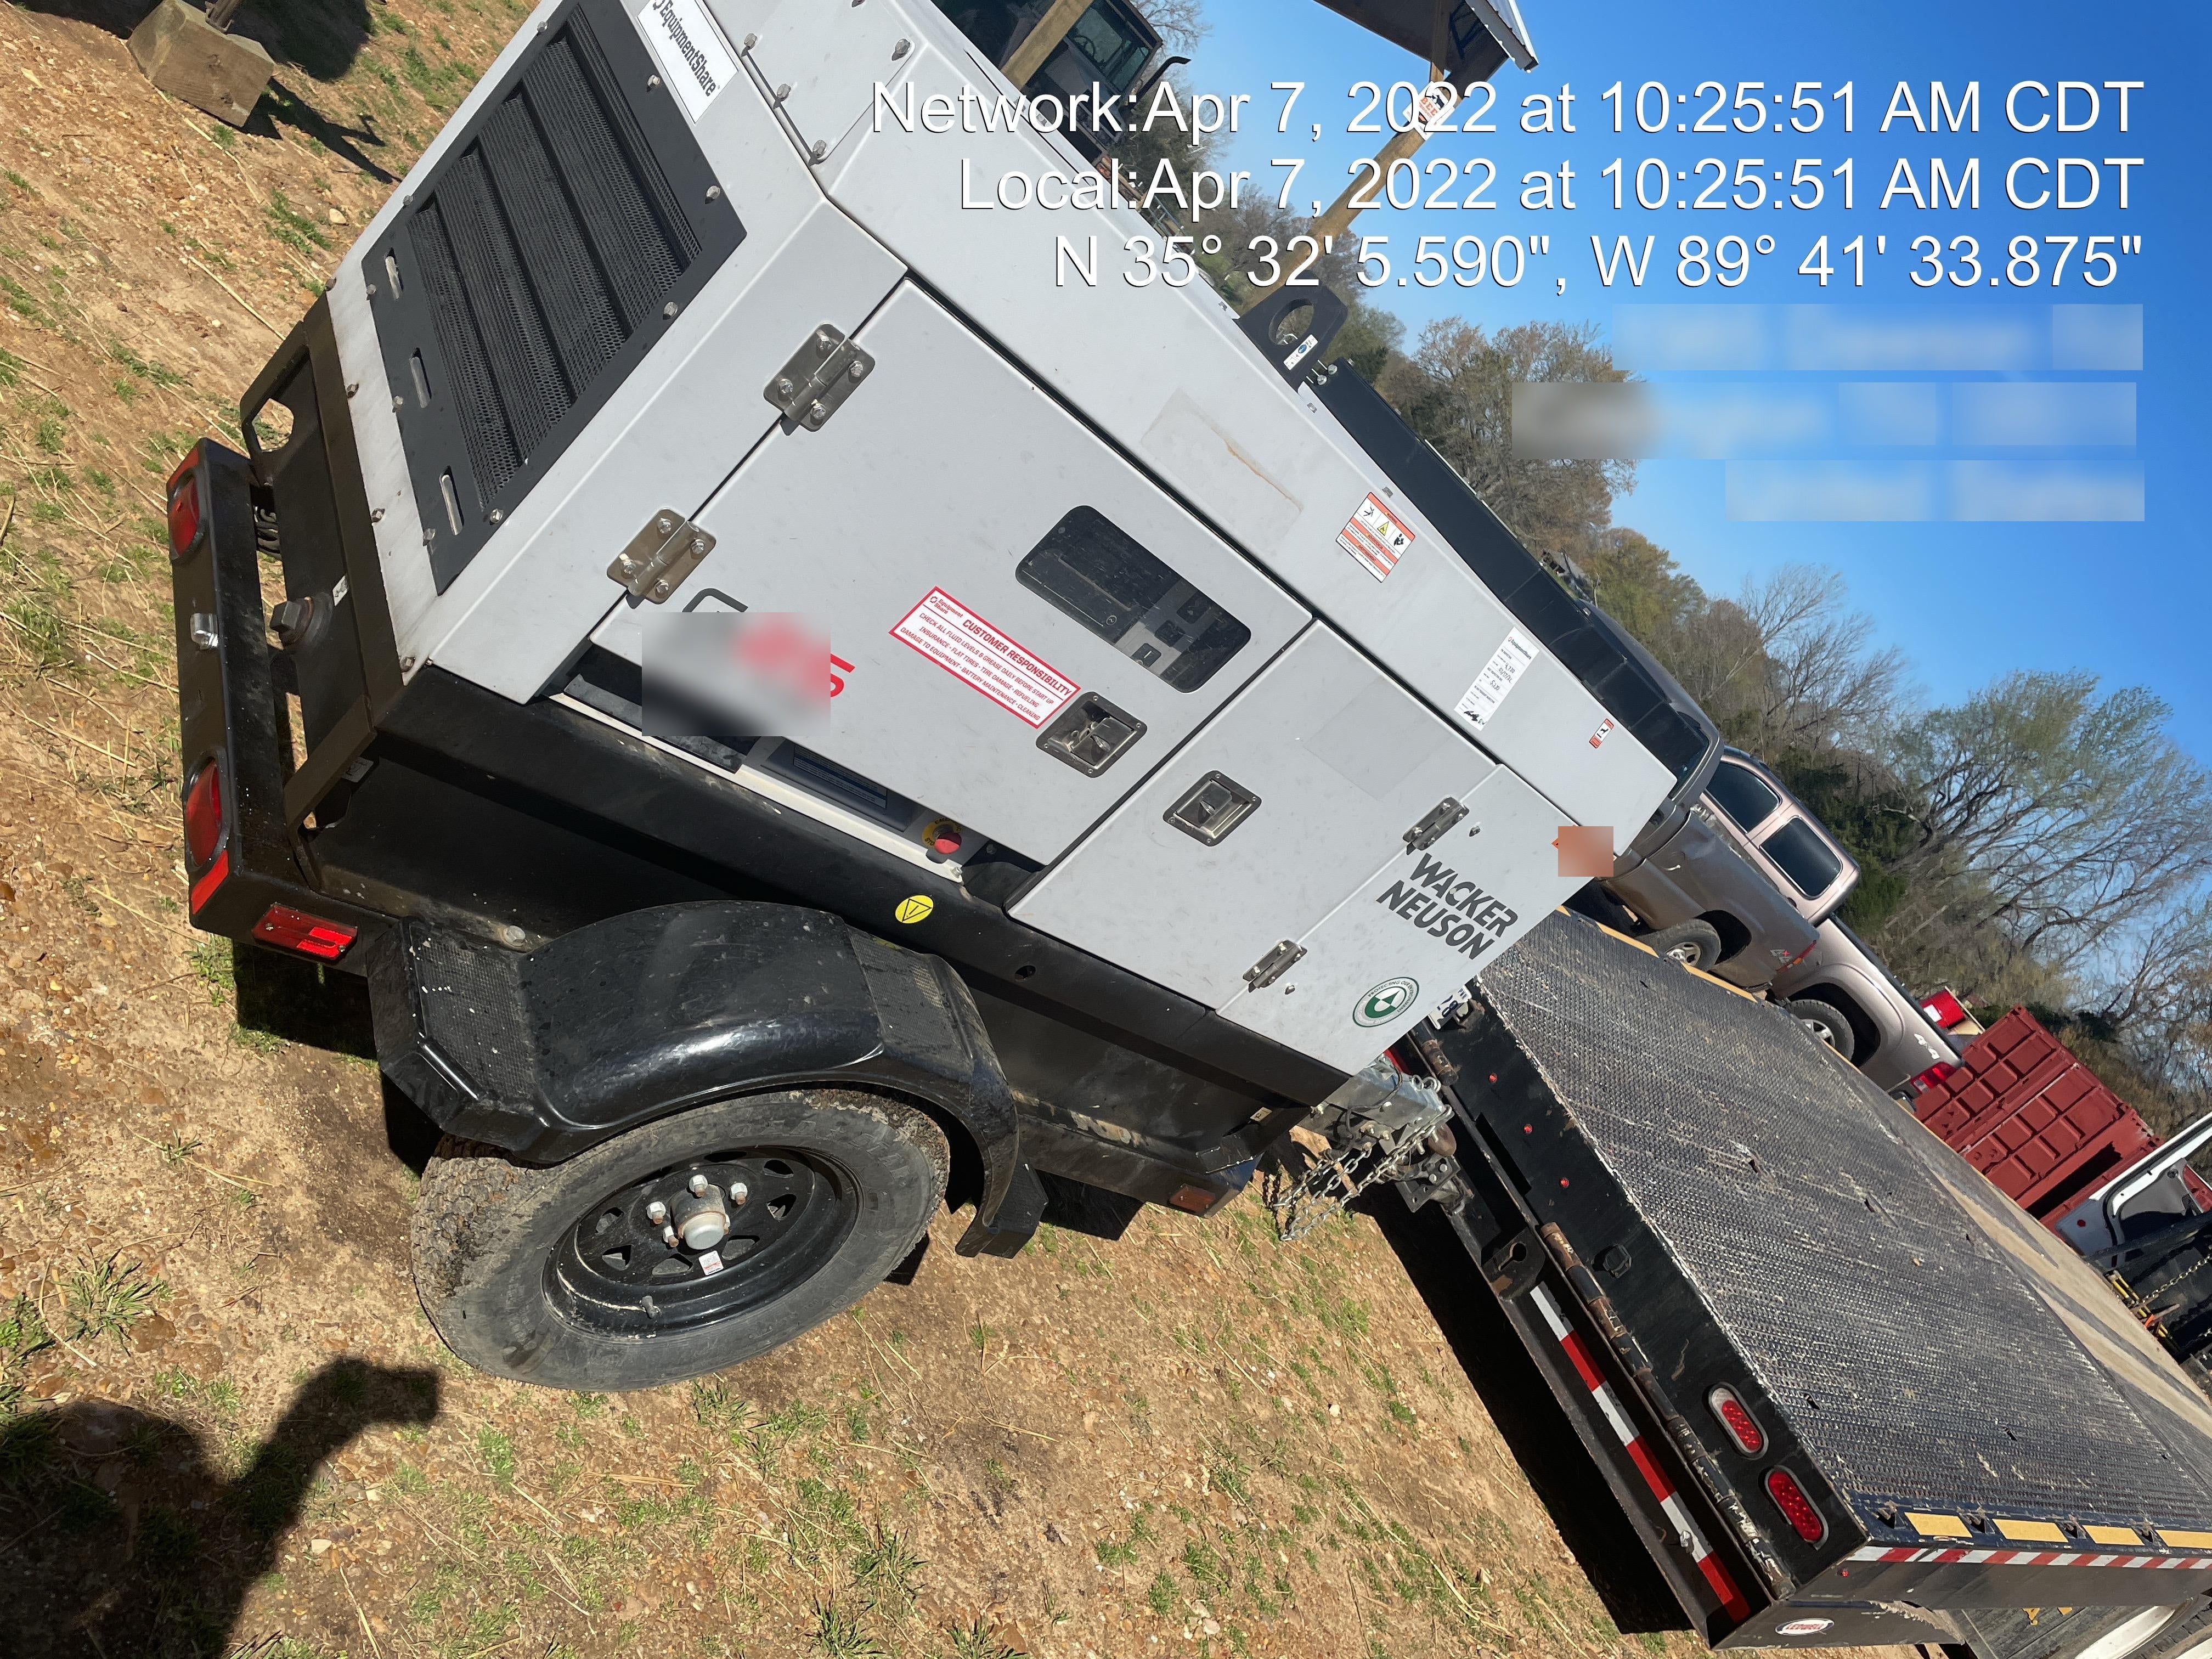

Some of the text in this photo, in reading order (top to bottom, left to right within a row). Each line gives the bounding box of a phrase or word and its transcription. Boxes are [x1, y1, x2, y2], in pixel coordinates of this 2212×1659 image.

[659, 0, 716, 97] EquipmentShare
[938, 599, 963, 618] Equipment
[900, 627, 924, 644] DAMAGE
[929, 646, 961, 668] EQUIPMENT
[961, 667, 984, 683] BATTERY
[981, 680, 1017, 705] MAINTENANCE
[1017, 704, 1041, 720] CLEANING
[919, 612, 938, 627] CHECK
[936, 624, 947, 634] ALL
[945, 630, 962, 644] FLUID
[960, 640, 980, 655] LEVELS
[983, 656, 1003, 670] GREASE
[1000, 668, 1017, 679] DAILY
[1014, 677, 1034, 691] BEFORE
[1031, 689, 1048, 700] START
[919, 627, 1040, 708] INSURANCE FLAT TIRES TIRE DAMAGE REFUELING
[962, 619, 1073, 696] CUSTOMER RESPONSIBILITY
[1375, 879, 1496, 960] NEUSON
[1409, 853, 1519, 938] WACKER
